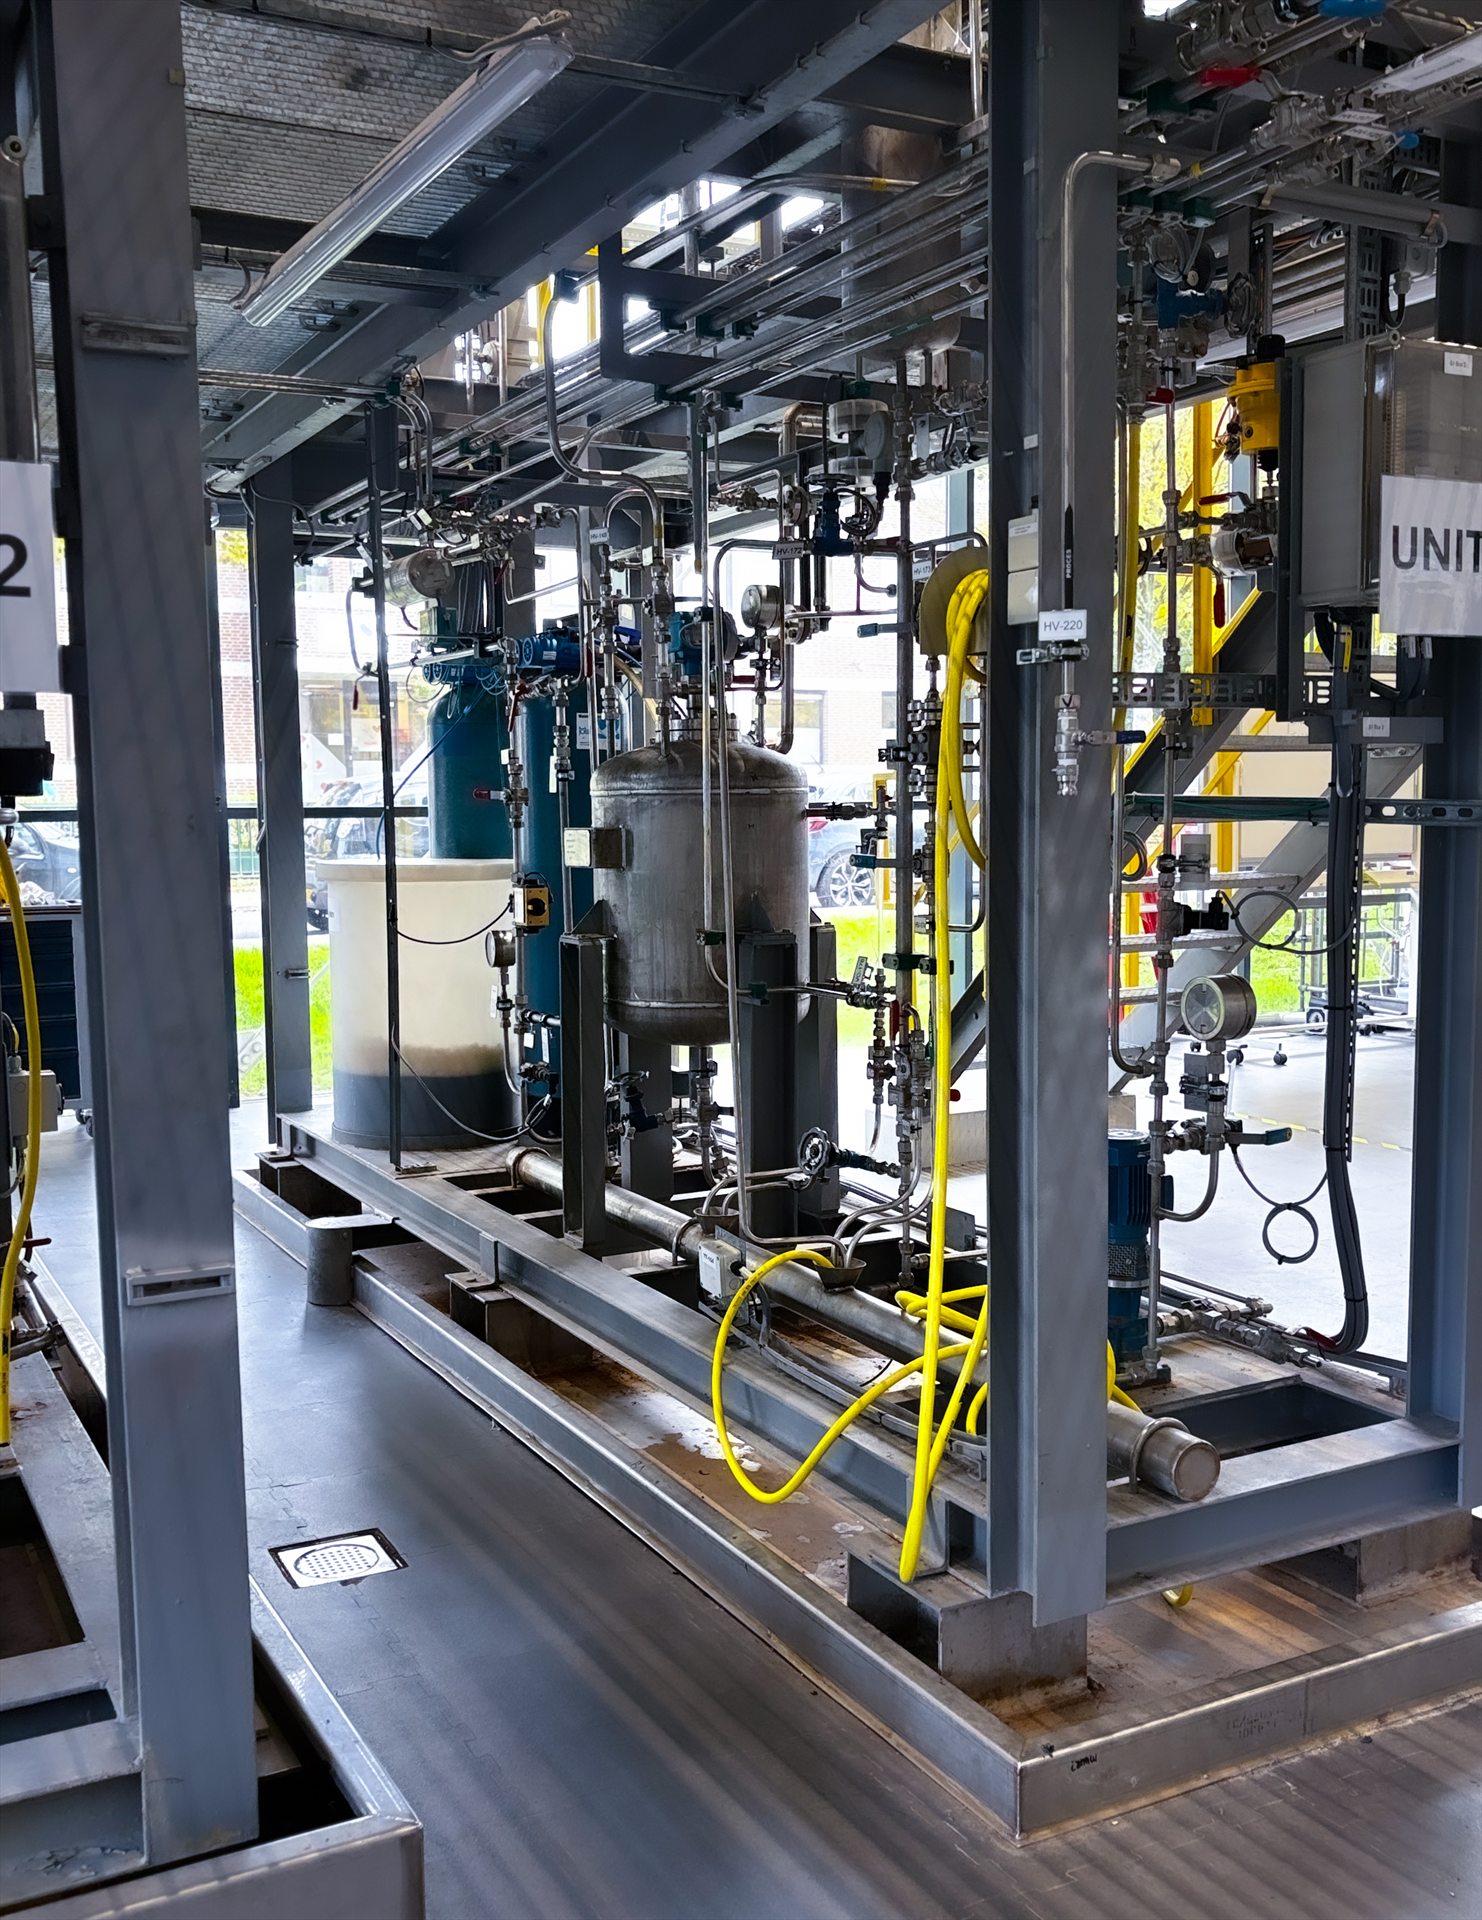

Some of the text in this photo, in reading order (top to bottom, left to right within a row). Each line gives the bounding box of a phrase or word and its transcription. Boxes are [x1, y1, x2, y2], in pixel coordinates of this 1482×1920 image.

[0, 533, 31, 598] 2
[1392, 525, 1482, 573] UNIT
[1043, 620, 1083, 632] HV-220
